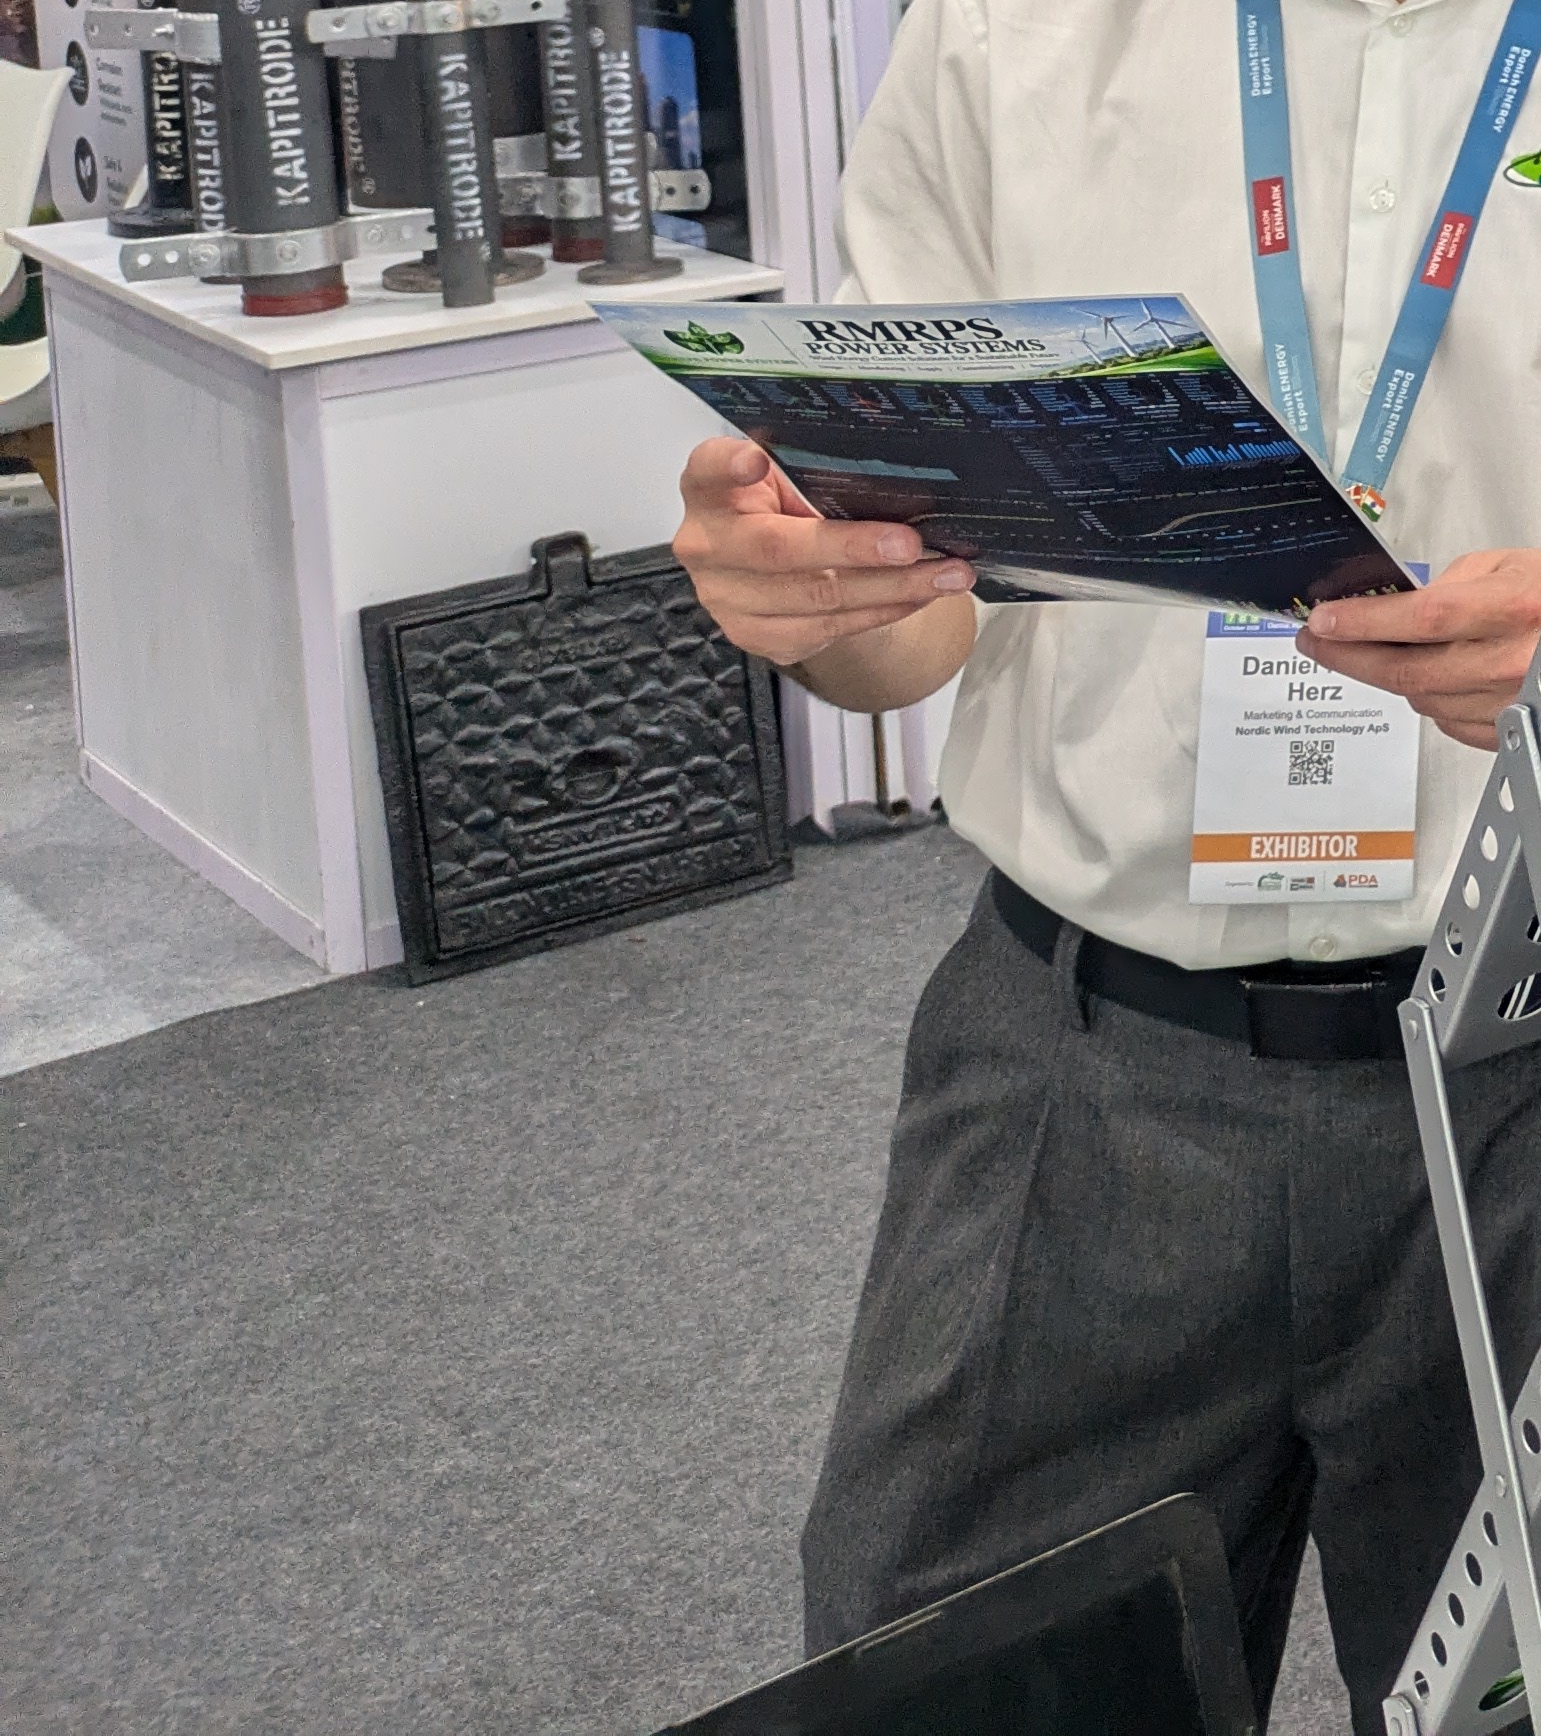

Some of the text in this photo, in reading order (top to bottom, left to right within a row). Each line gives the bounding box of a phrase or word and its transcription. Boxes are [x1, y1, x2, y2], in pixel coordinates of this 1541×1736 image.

[1260, 57, 1273, 96] Export
[1499, 46, 1521, 84] Export
[254, 16, 312, 207] KAPITRODE
[551, 21, 584, 161] KAPITRO
[152, 51, 185, 181] KAPITRO
[190, 72, 226, 232] KAPITROD
[439, 52, 484, 241] KAPITRODE
[599, 50, 642, 232] KAPITRODE
[1271, 184, 1286, 241] DENMARK
[1426, 223, 1454, 278] DENMARK
[797, 317, 1003, 342] RMRPS
[802, 338, 1046, 355] POWER SYSTEMS
[1382, 368, 1405, 409] Export
[1294, 389, 1309, 432] Export
[1287, 682, 1344, 702] Herz
[1235, 721, 1390, 737] Nordic Wind Technology ApS
[1243, 709, 1294, 722] Marketing
[1306, 707, 1383, 720] Communication
[1250, 833, 1358, 860] EXHIBITOR
